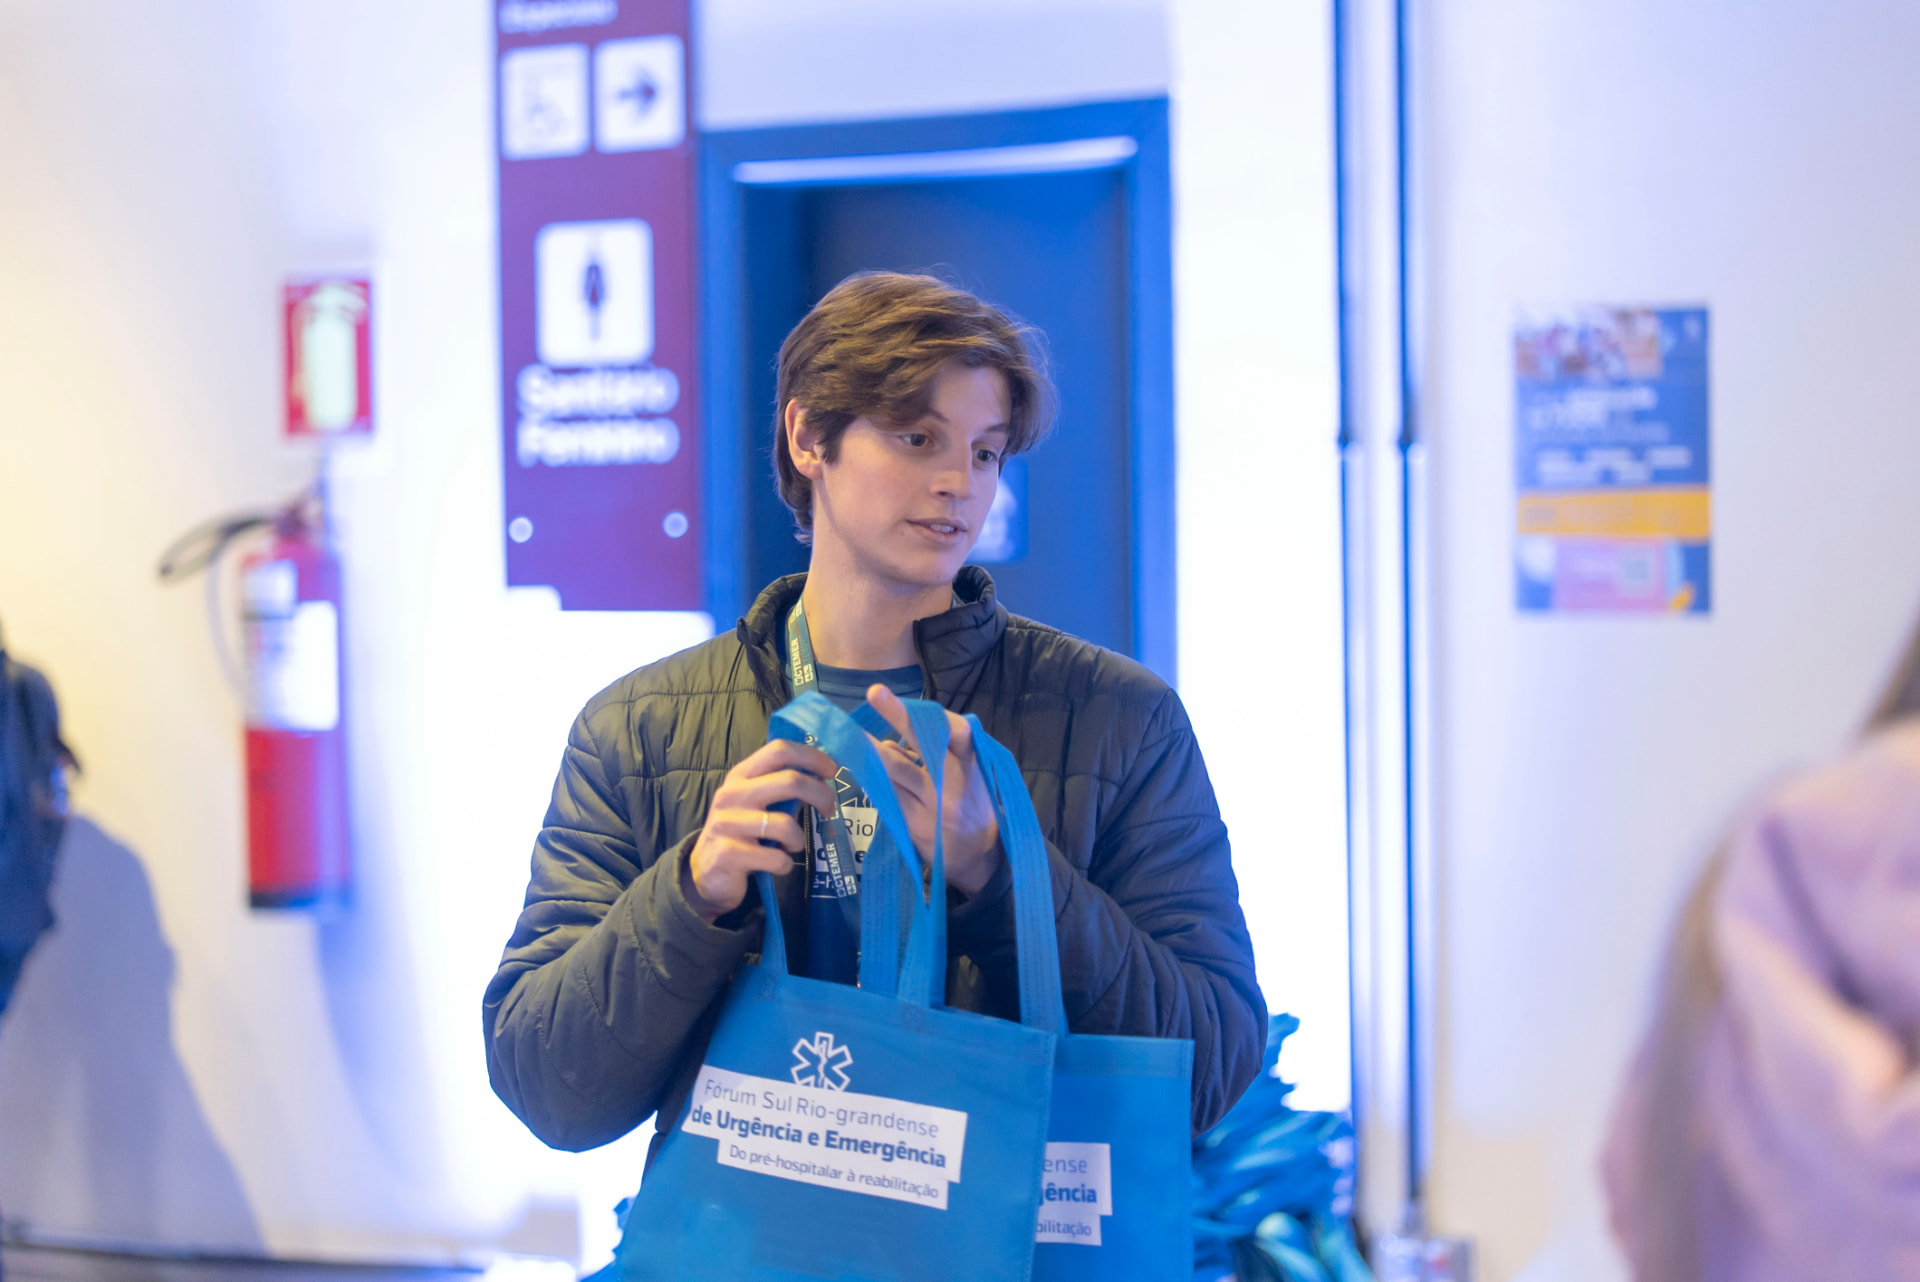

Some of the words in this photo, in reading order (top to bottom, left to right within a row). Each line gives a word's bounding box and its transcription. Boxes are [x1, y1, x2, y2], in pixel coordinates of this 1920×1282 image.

[691, 1105, 713, 1126] de
[717, 1109, 803, 1143] Urgência
[807, 1131, 820, 1146] e
[825, 1129, 946, 1168] Emergência
[704, 1079, 757, 1107] Fórum
[762, 1091, 792, 1113] Sul
[796, 1097, 939, 1138] Rio-grandense
[729, 1144, 747, 1160] Do
[749, 1152, 842, 1179] pré-hospitalar
[859, 1173, 939, 1198] reabilitação
